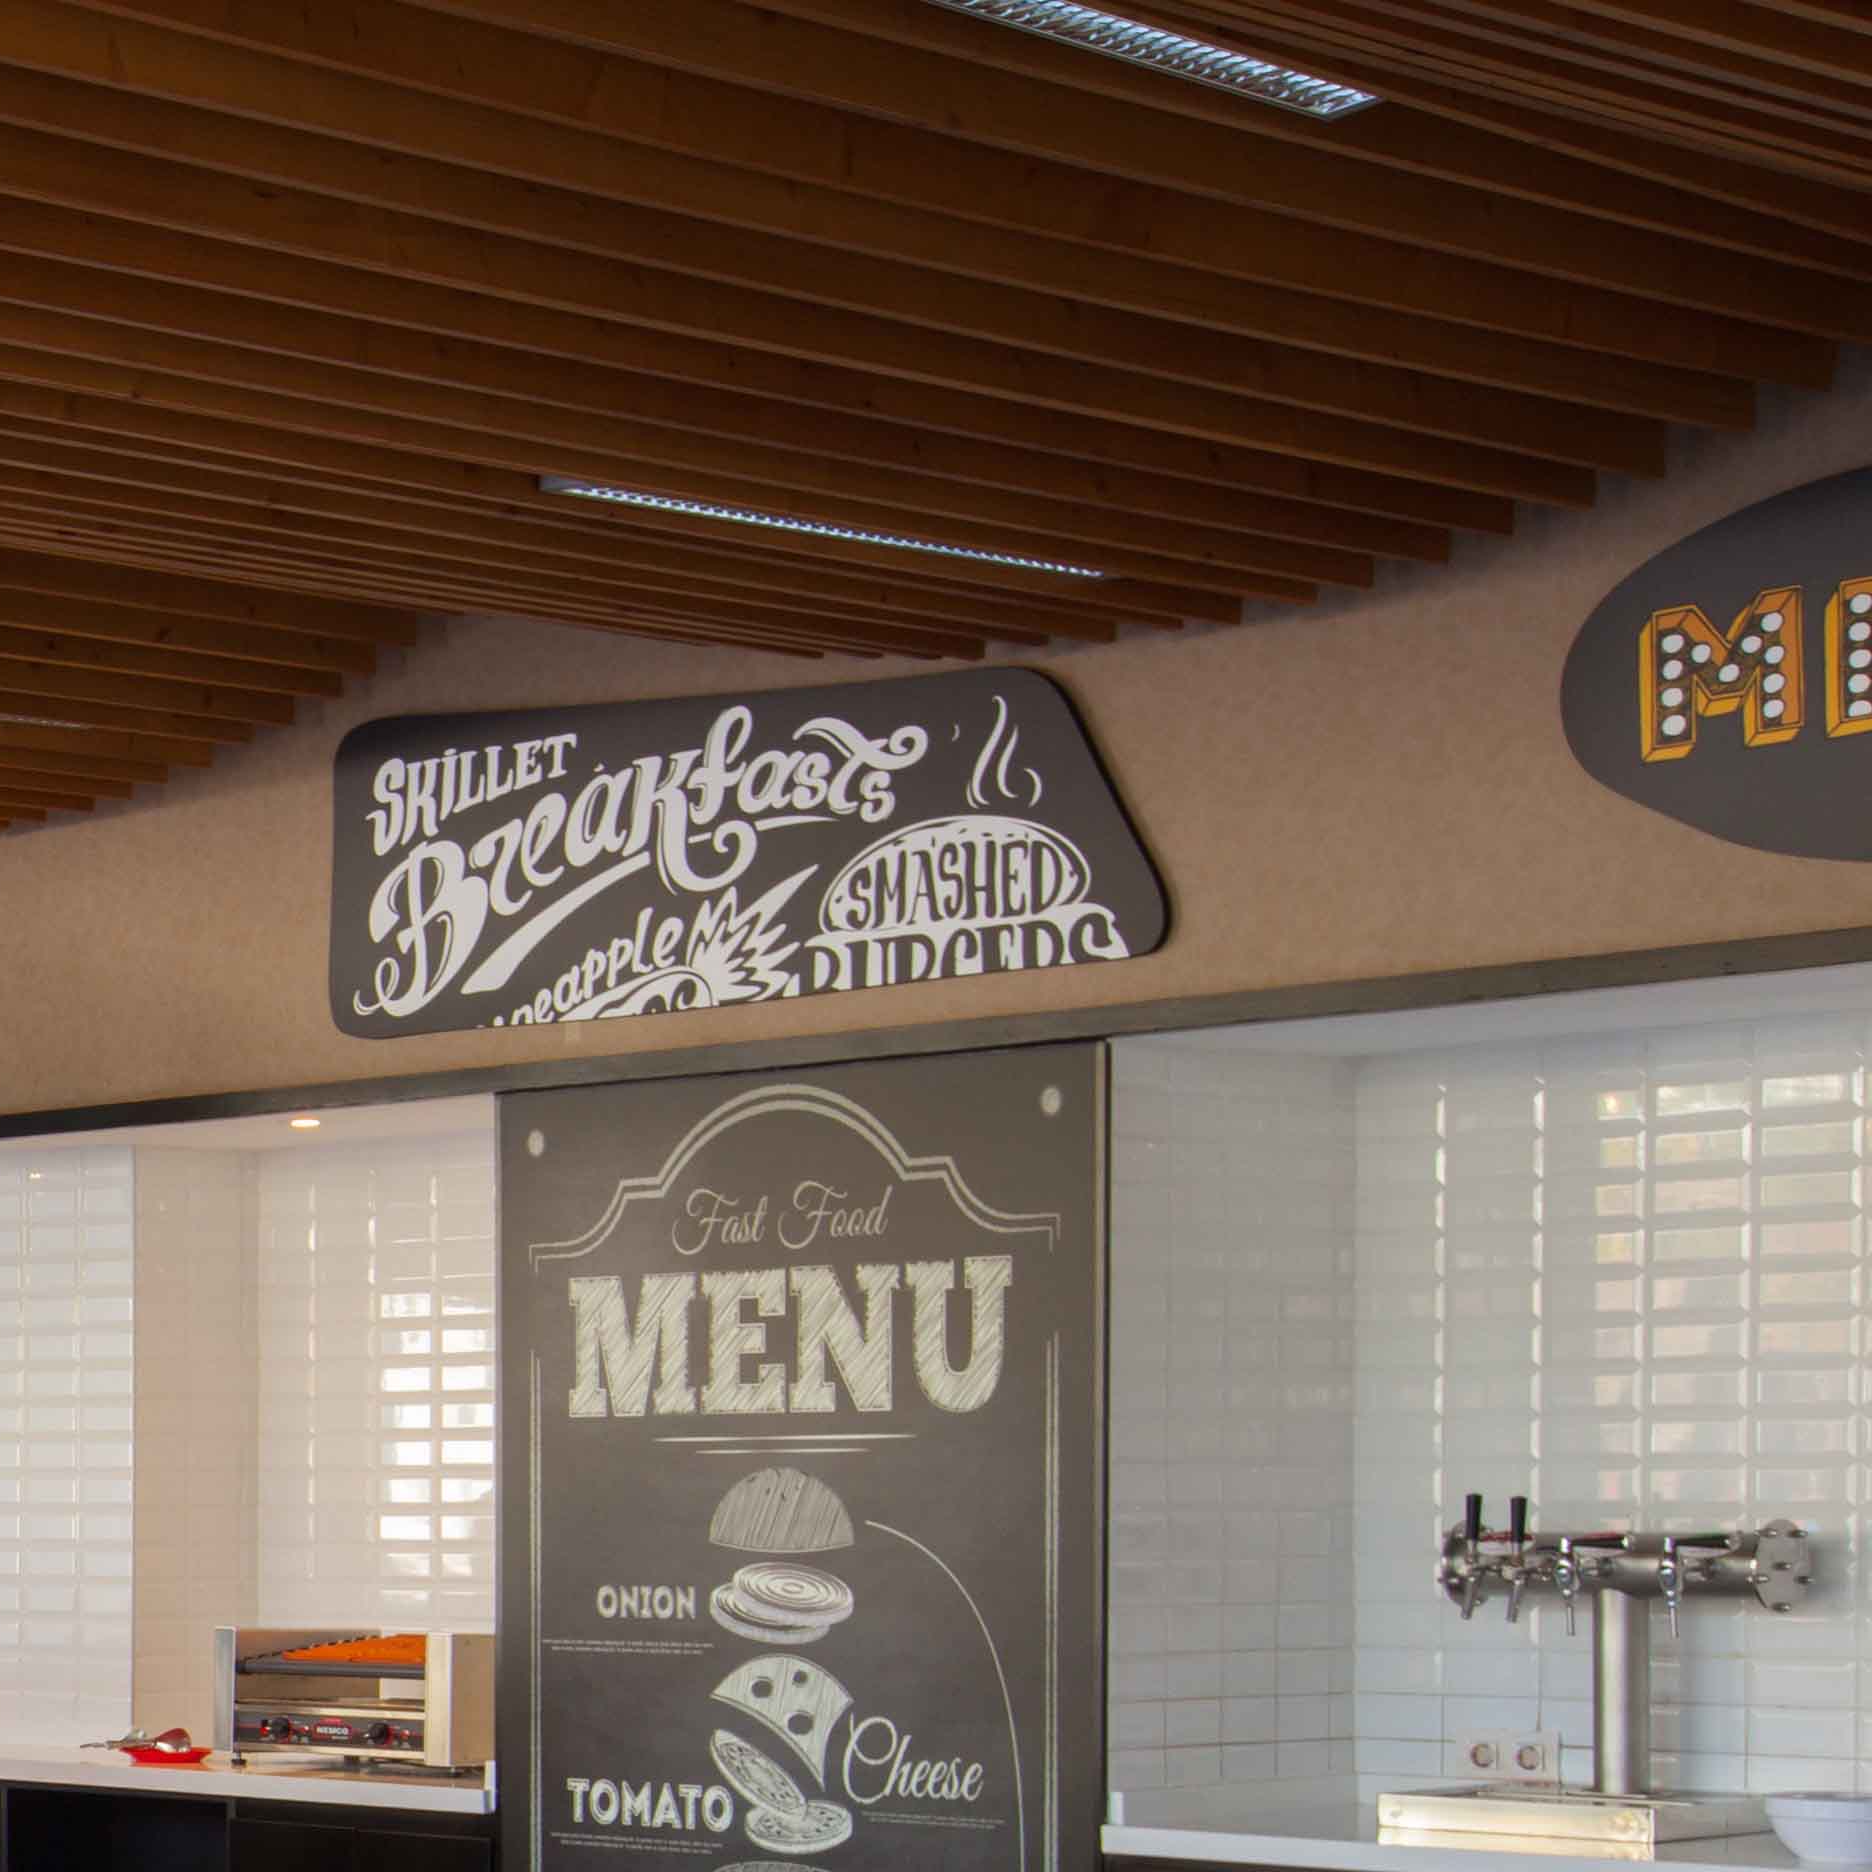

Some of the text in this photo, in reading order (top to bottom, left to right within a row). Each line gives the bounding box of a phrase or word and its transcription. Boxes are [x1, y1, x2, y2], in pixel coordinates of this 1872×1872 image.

[354, 705, 928, 1016] Breakfasts
[846, 839, 1064, 929] SMASHED
[671, 1180, 894, 1256] Fast Food
[568, 1256, 1013, 1417] MENU
[596, 1585, 697, 1620] ONION
[841, 1713, 985, 1805] Cheese
[566, 1778, 734, 1833] TOMATO
